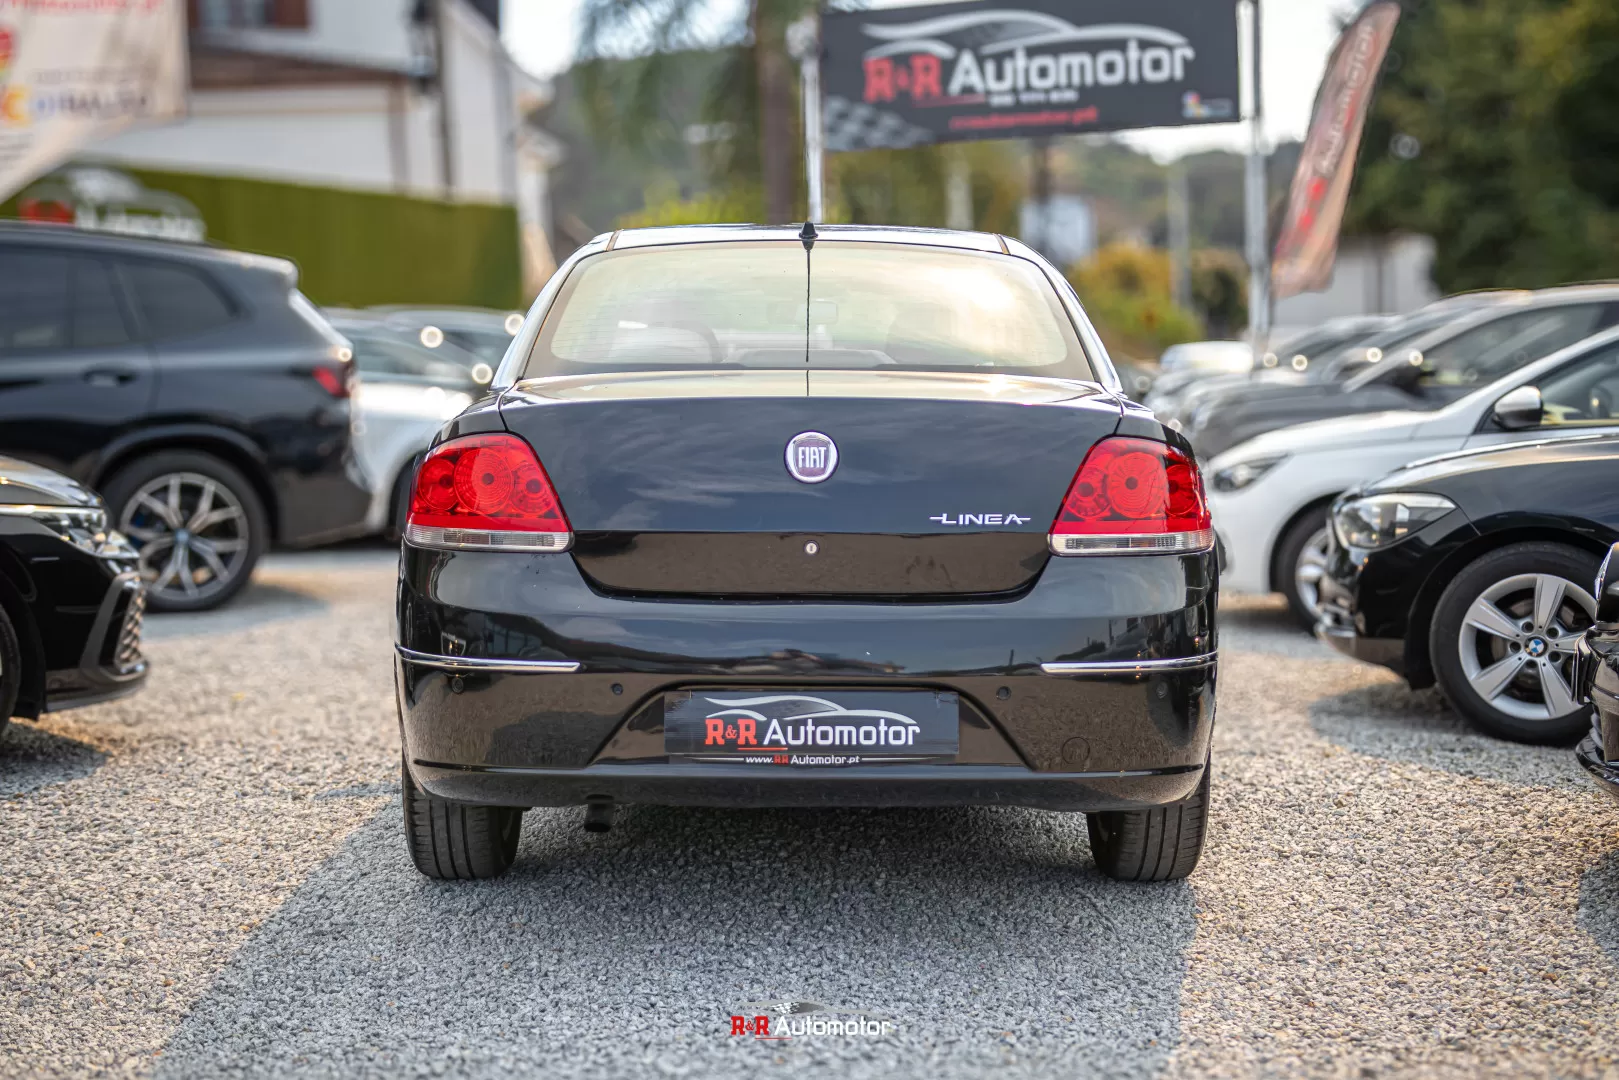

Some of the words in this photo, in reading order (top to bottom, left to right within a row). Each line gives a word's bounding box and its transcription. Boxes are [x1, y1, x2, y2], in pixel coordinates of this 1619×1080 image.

[948, 38, 1196, 96] Automotor
[798, 446, 827, 468] FIAT
[929, 513, 1031, 526] LINEA
[704, 719, 758, 746] R&R
[763, 718, 921, 746] Automotor
